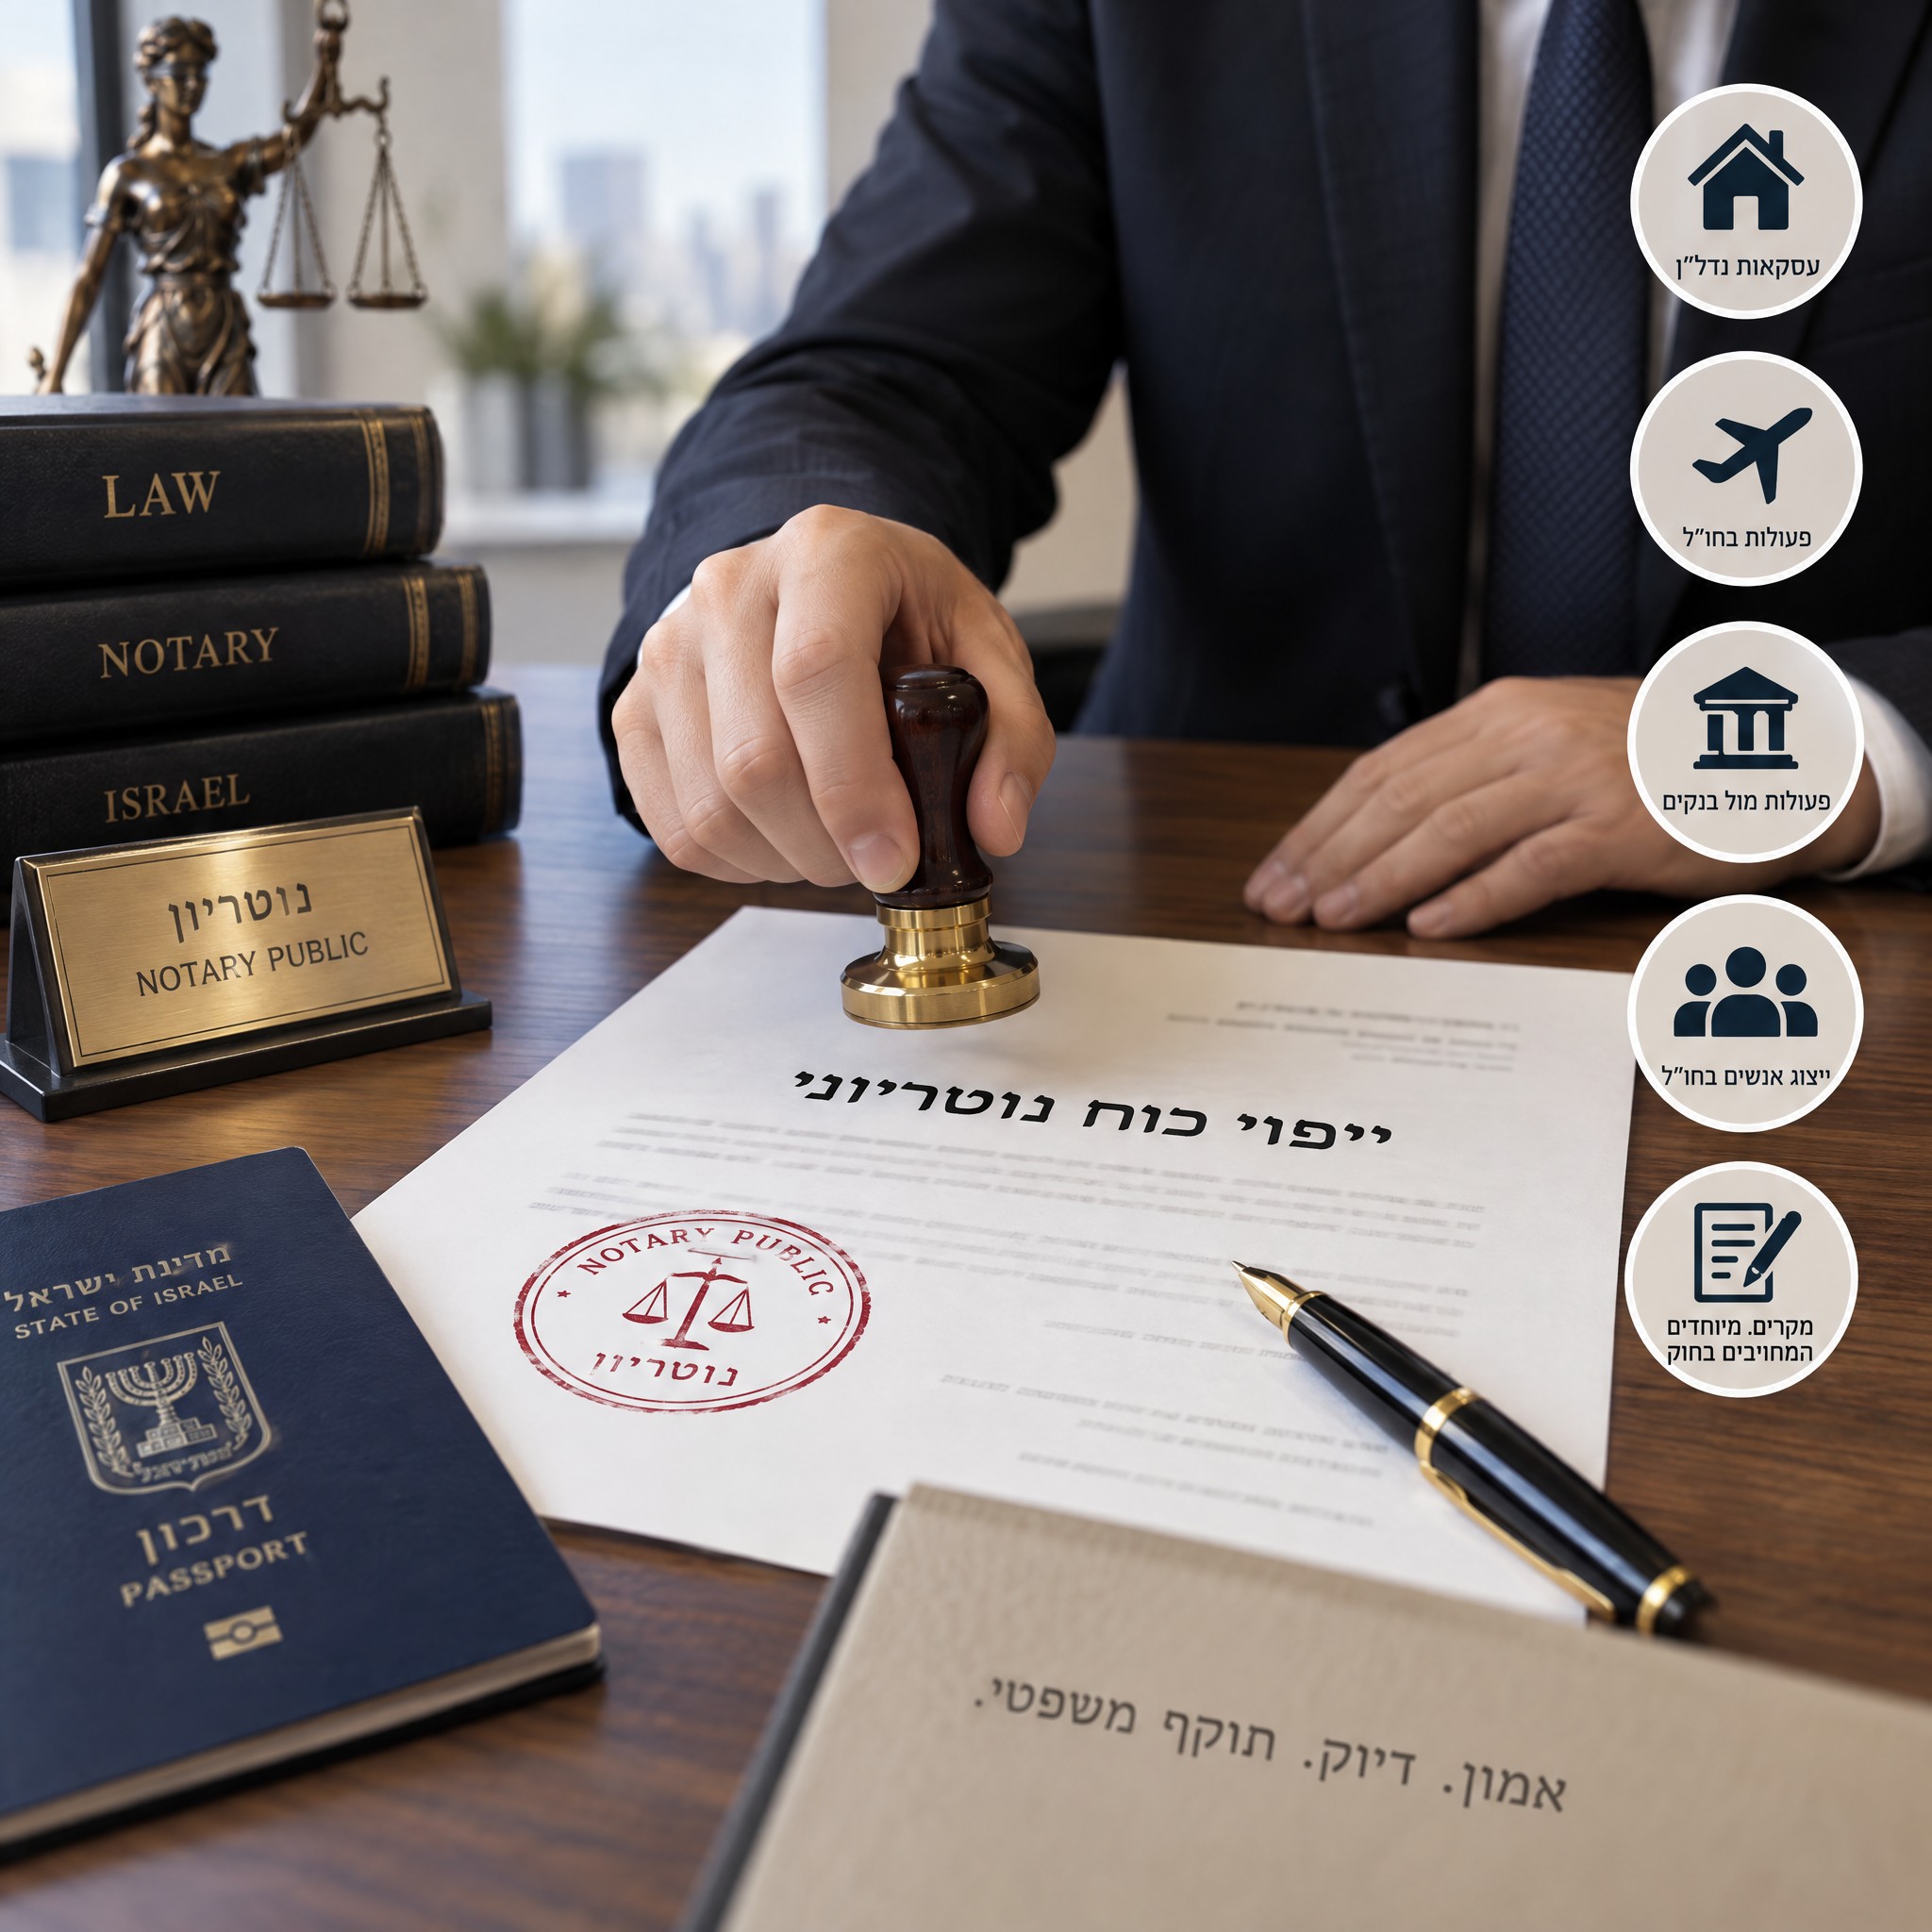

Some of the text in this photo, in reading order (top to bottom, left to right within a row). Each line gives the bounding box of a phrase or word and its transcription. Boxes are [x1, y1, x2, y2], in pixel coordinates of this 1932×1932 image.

[102, 471, 221, 518] LAW
[98, 626, 279, 678] NOTARY
[104, 773, 251, 824] ISRAEL
[168, 882, 312, 943] נוטריון
[136, 931, 369, 997] NOTARY PUBLIC
[793, 1071, 1392, 1151] ייפוי כוח נוטריוני
[3, 1245, 232, 1312] מדינת ישראל
[576, 1227, 715, 1275] NOTARY
[730, 1229, 835, 1296] PUBLIC
[14, 1274, 243, 1340] STATE OF ISRAEL
[589, 1352, 740, 1387] נוטריון
[136, 1494, 274, 1567] דרכון
[120, 1531, 308, 1608] PASSPORT
[974, 1677, 1568, 1813] אמון. דיוק. תוקף משפטי.
